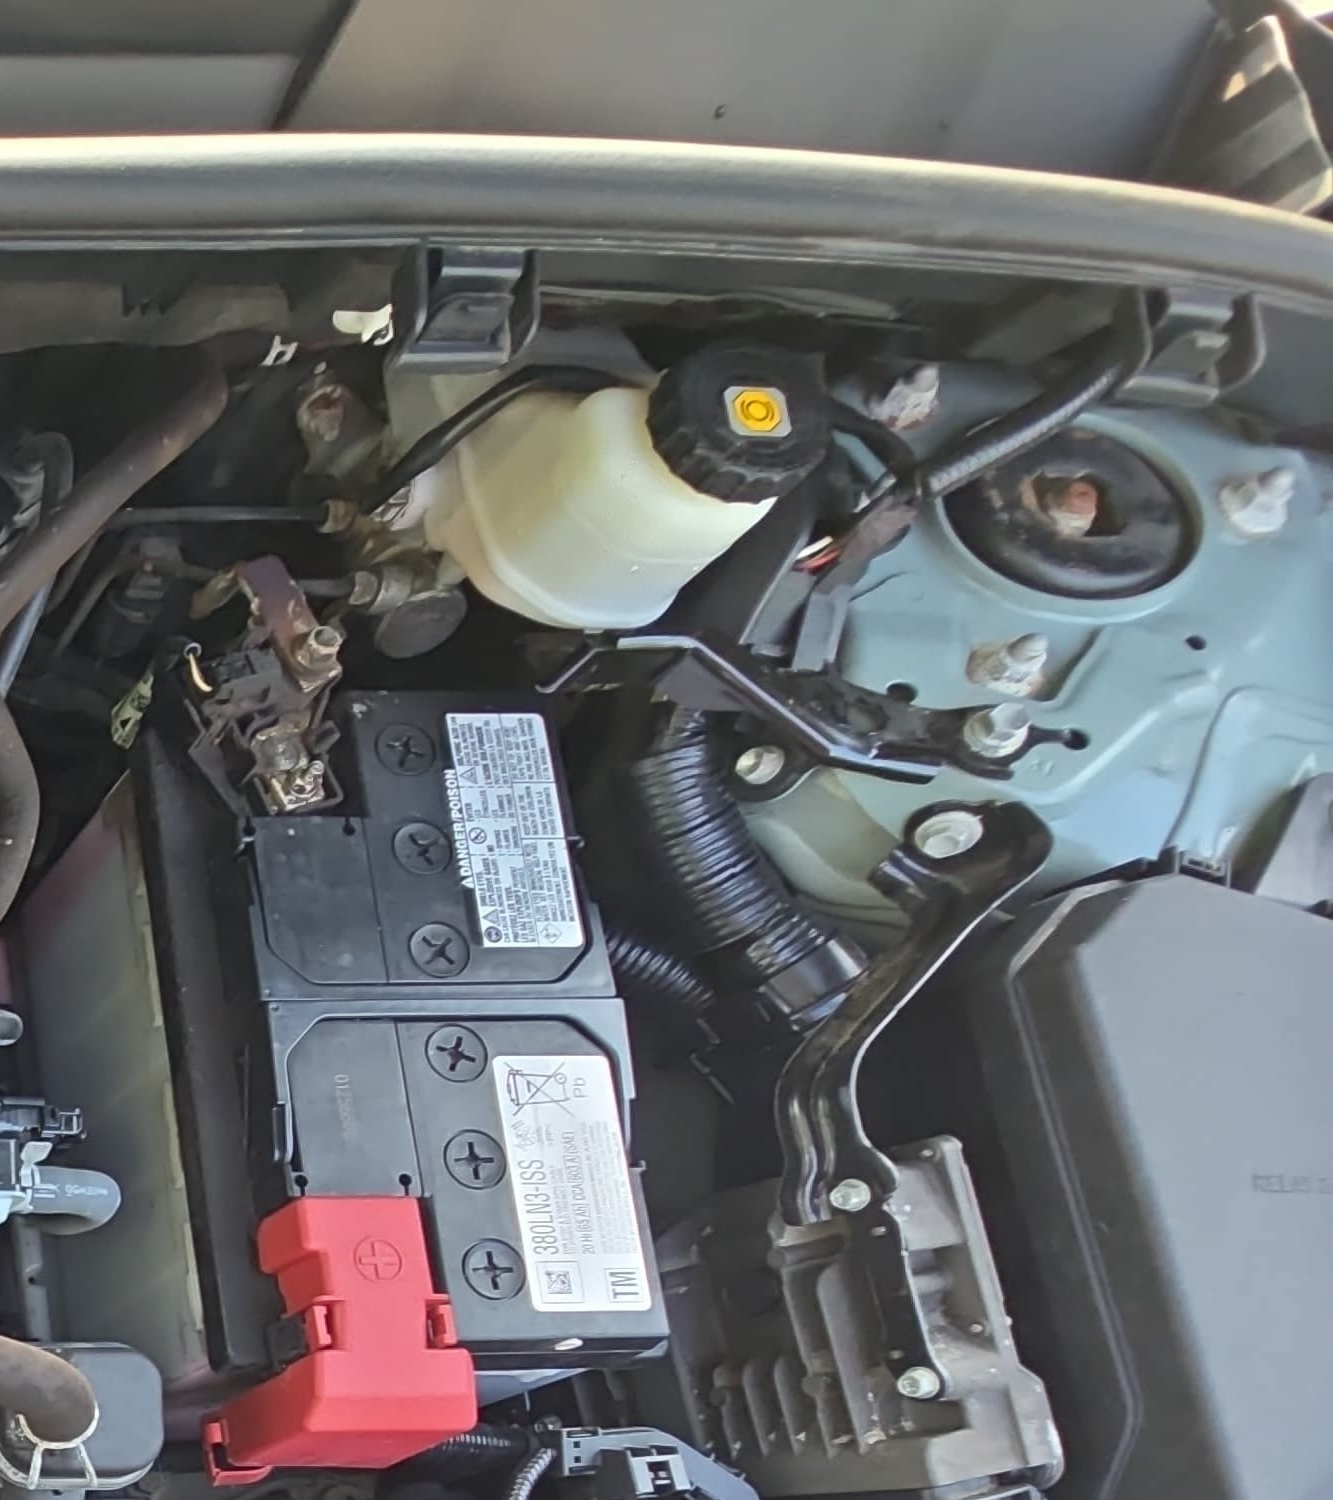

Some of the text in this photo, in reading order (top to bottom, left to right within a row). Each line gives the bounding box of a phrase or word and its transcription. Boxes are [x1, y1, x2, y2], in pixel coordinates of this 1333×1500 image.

[445, 769, 472, 877] DANGER/POISON
[569, 1077, 589, 1099] Pb
[517, 1158, 559, 1255] 380LN3-ISS
[607, 1269, 641, 1300] TM
